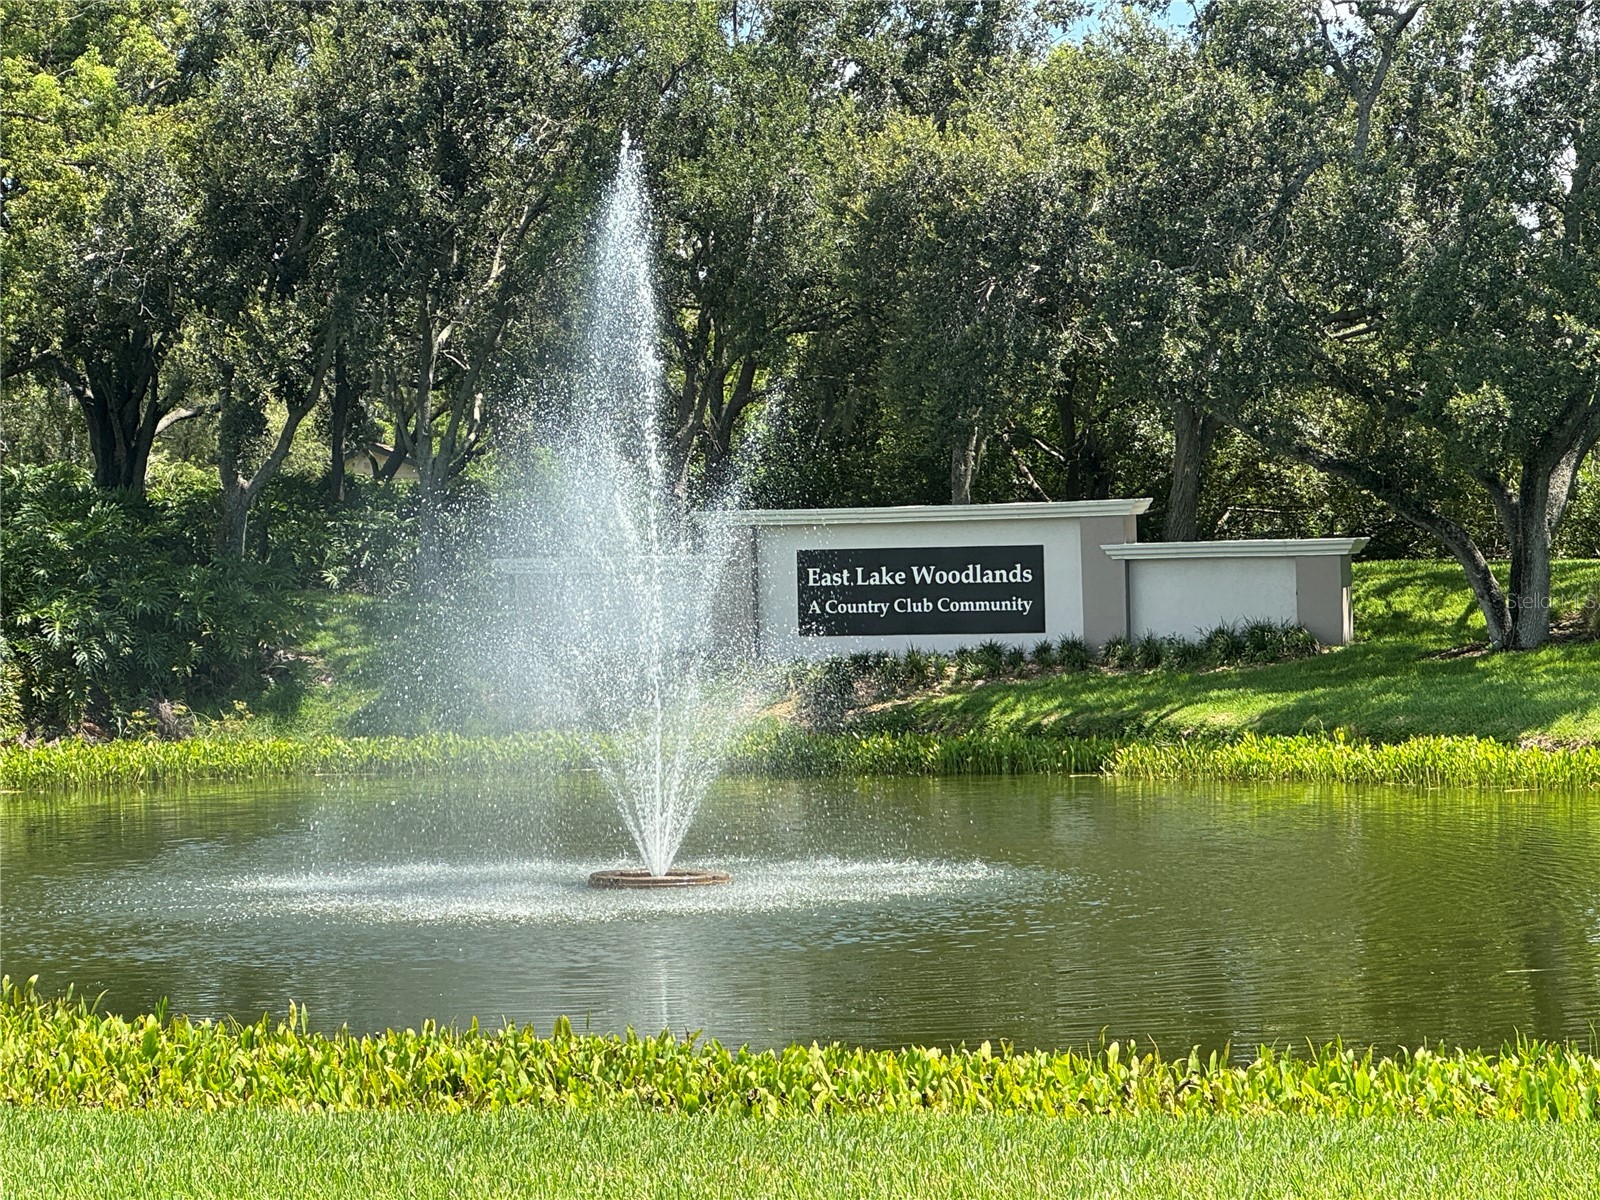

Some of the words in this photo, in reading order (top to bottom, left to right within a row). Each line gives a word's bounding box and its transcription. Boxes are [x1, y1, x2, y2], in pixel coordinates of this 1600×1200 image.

[807, 567, 850, 586] East
[856, 566, 906, 586] Lake
[911, 564, 1033, 585] Woodlands
[808, 600, 821, 615] A
[825, 600, 890, 617] Country
[893, 598, 933, 614] Club
[937, 597, 1033, 616] Community
